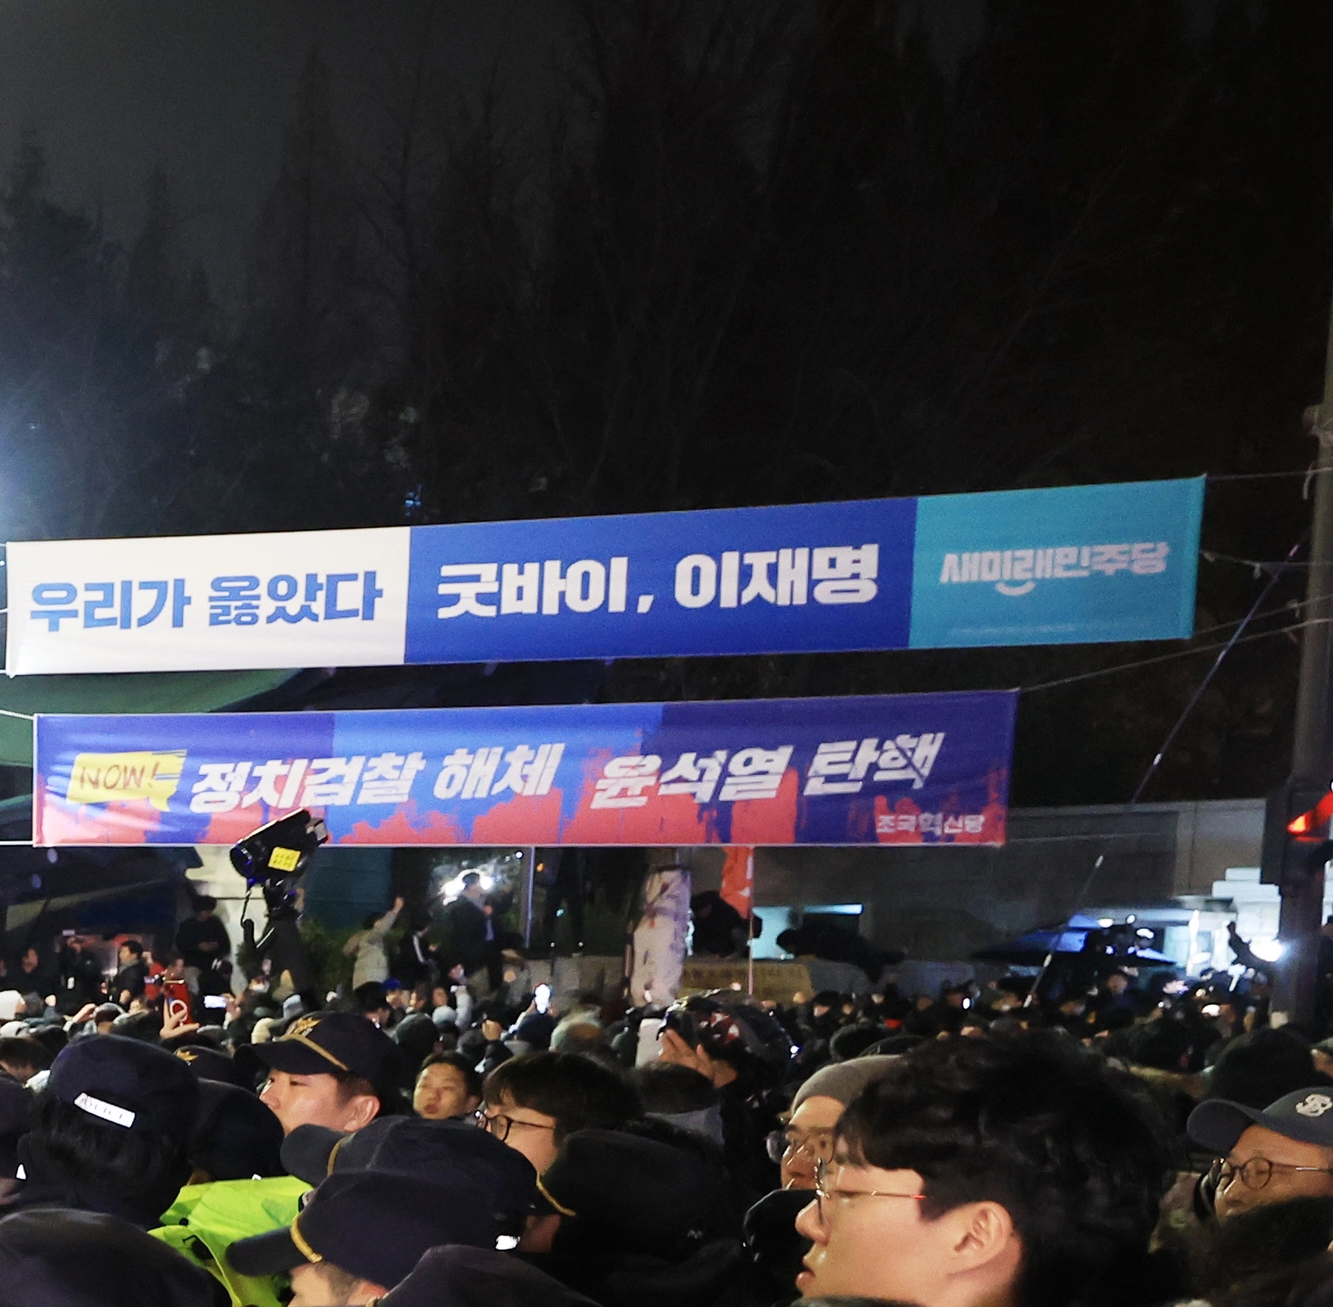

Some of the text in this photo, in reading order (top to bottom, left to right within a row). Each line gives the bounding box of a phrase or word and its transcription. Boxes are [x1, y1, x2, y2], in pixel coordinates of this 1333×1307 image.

[437, 544, 879, 619] 굿바이, 이재명
[940, 542, 1172, 584] 새미래민주당
[31, 571, 383, 632] 우리가 옳았다
[79, 761, 159, 791] NOW!
[190, 732, 945, 814] 정치검찰 해체 윤석열 탄핵
[876, 813, 986, 836] 조국혁신당
